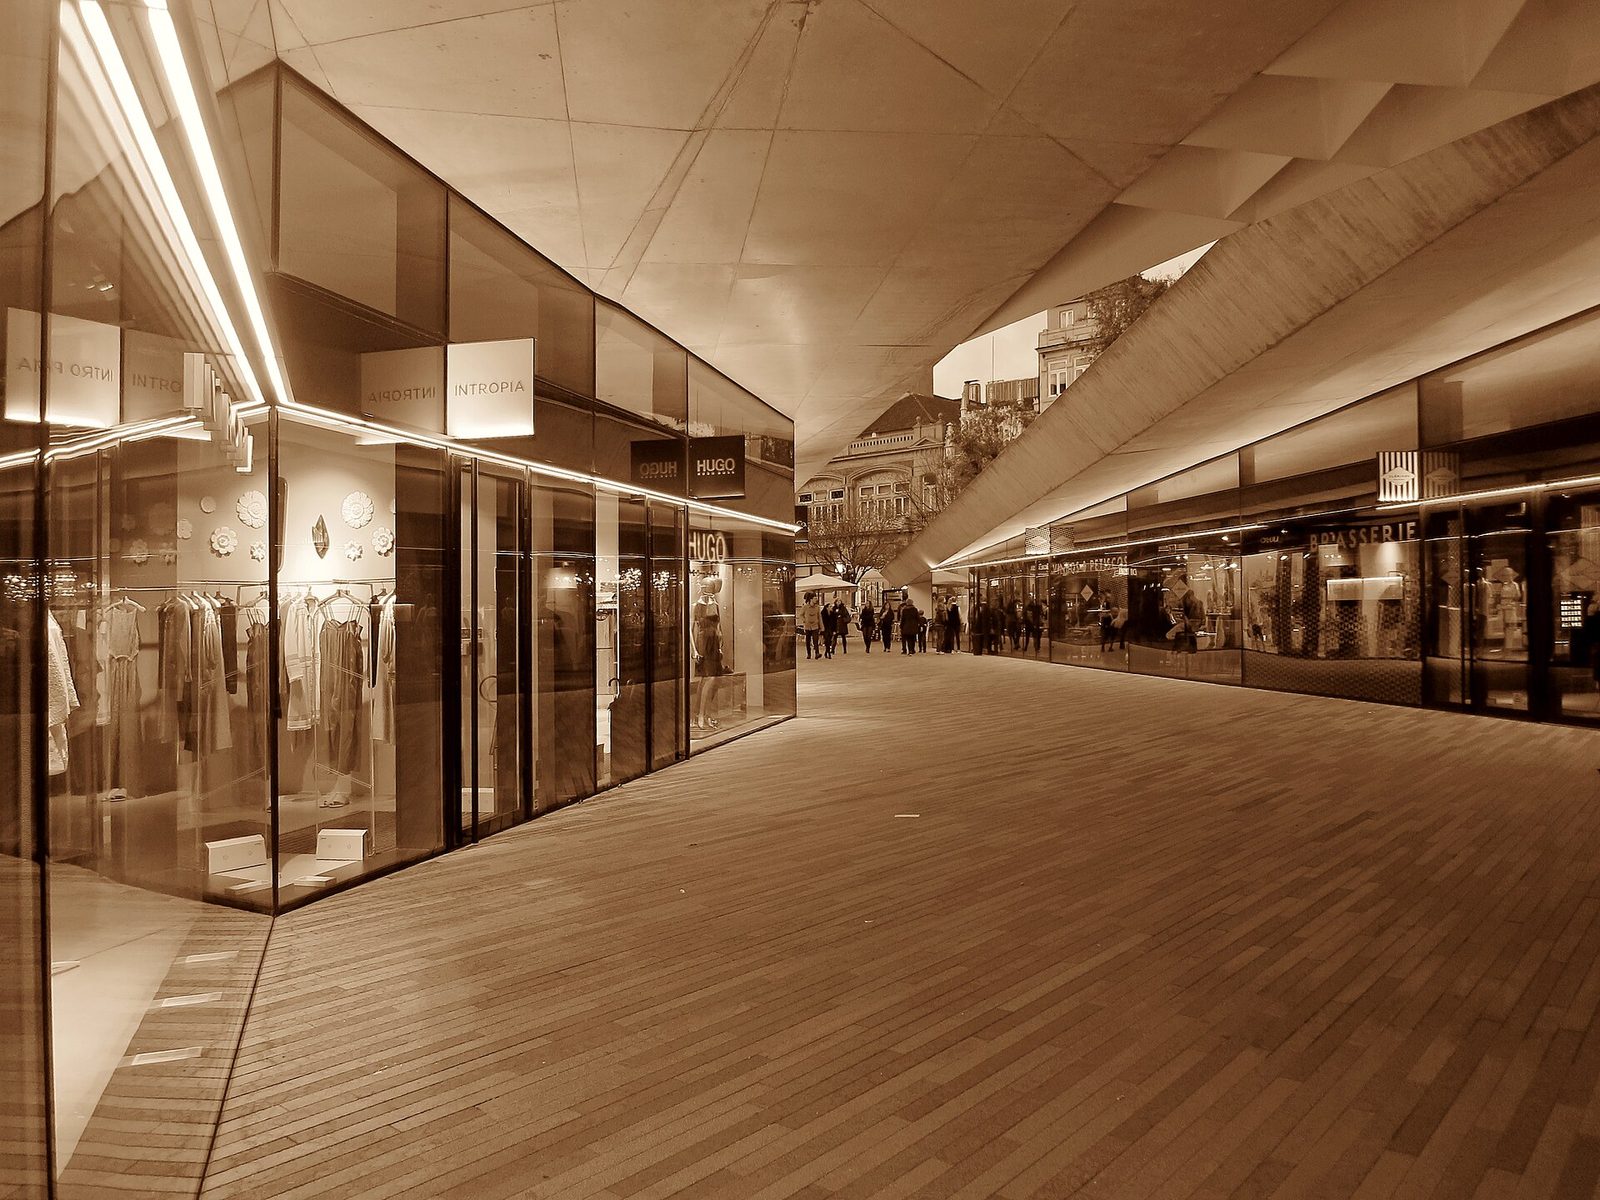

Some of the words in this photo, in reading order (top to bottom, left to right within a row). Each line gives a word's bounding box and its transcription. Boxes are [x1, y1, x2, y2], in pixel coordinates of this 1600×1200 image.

[132, 373, 183, 393] INTRO
[454, 381, 525, 396] INTROPIA
[697, 458, 735, 473] HUGO
[688, 531, 727, 562] HUGO
